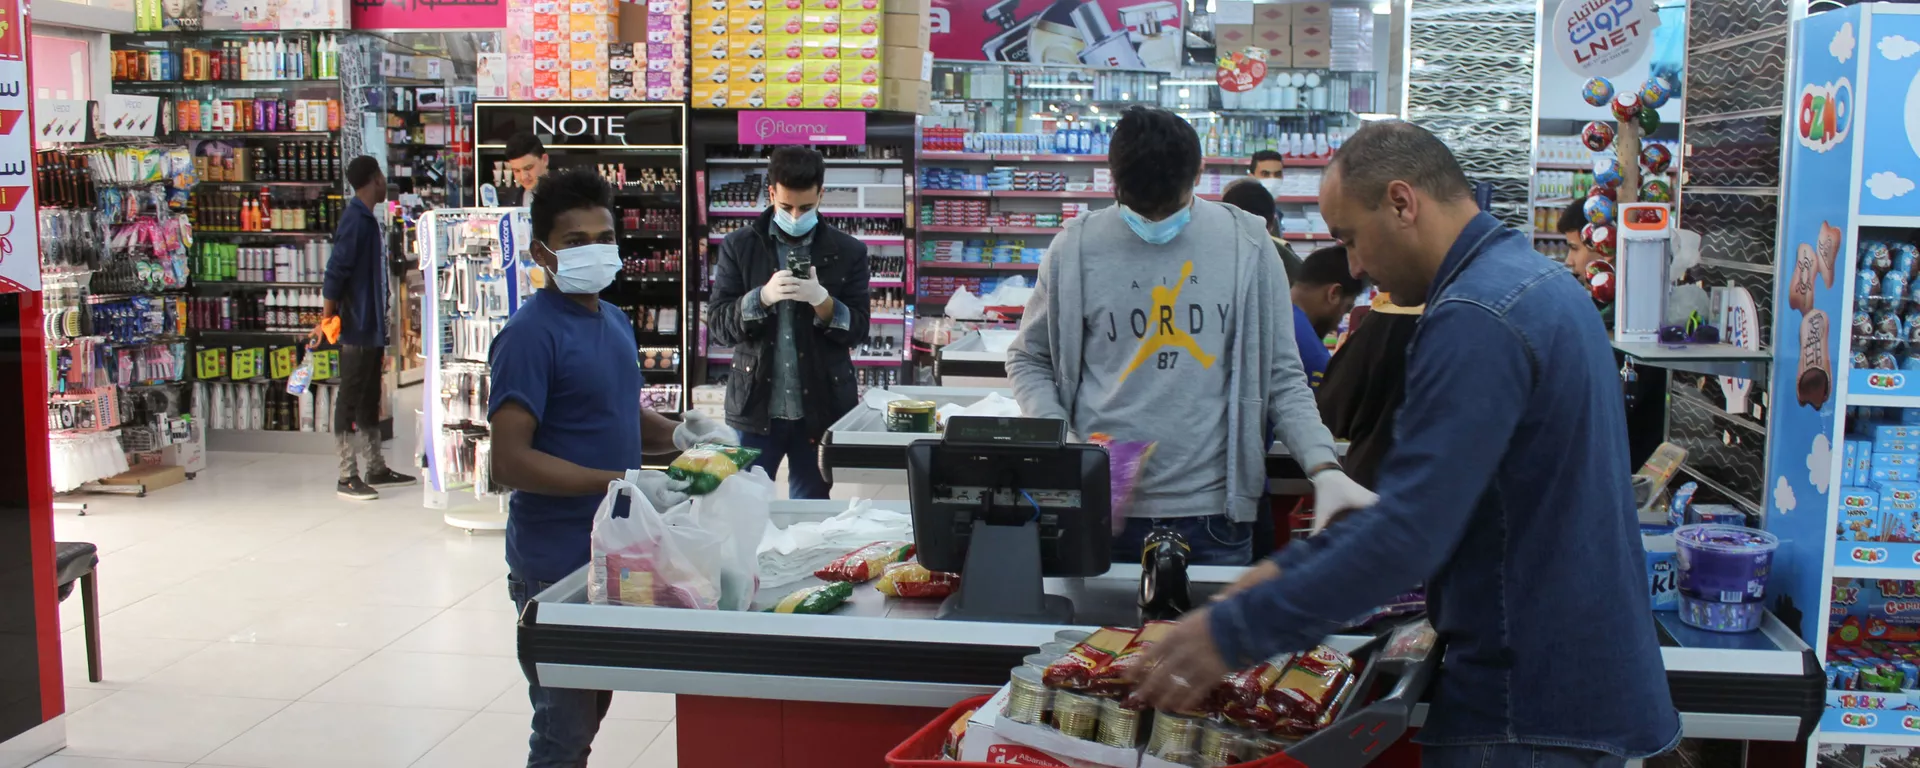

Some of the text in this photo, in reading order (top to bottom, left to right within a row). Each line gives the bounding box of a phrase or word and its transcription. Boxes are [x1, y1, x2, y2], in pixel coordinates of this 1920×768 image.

[1573, 19, 1641, 64] LNET
[1799, 85, 1851, 144] OZMO
[533, 115, 626, 137] NOTE
[776, 120, 827, 134] flormar
[1131, 275, 1198, 290] AIR
[1107, 303, 1230, 342] JORDY
[1157, 351, 1179, 370] 87
